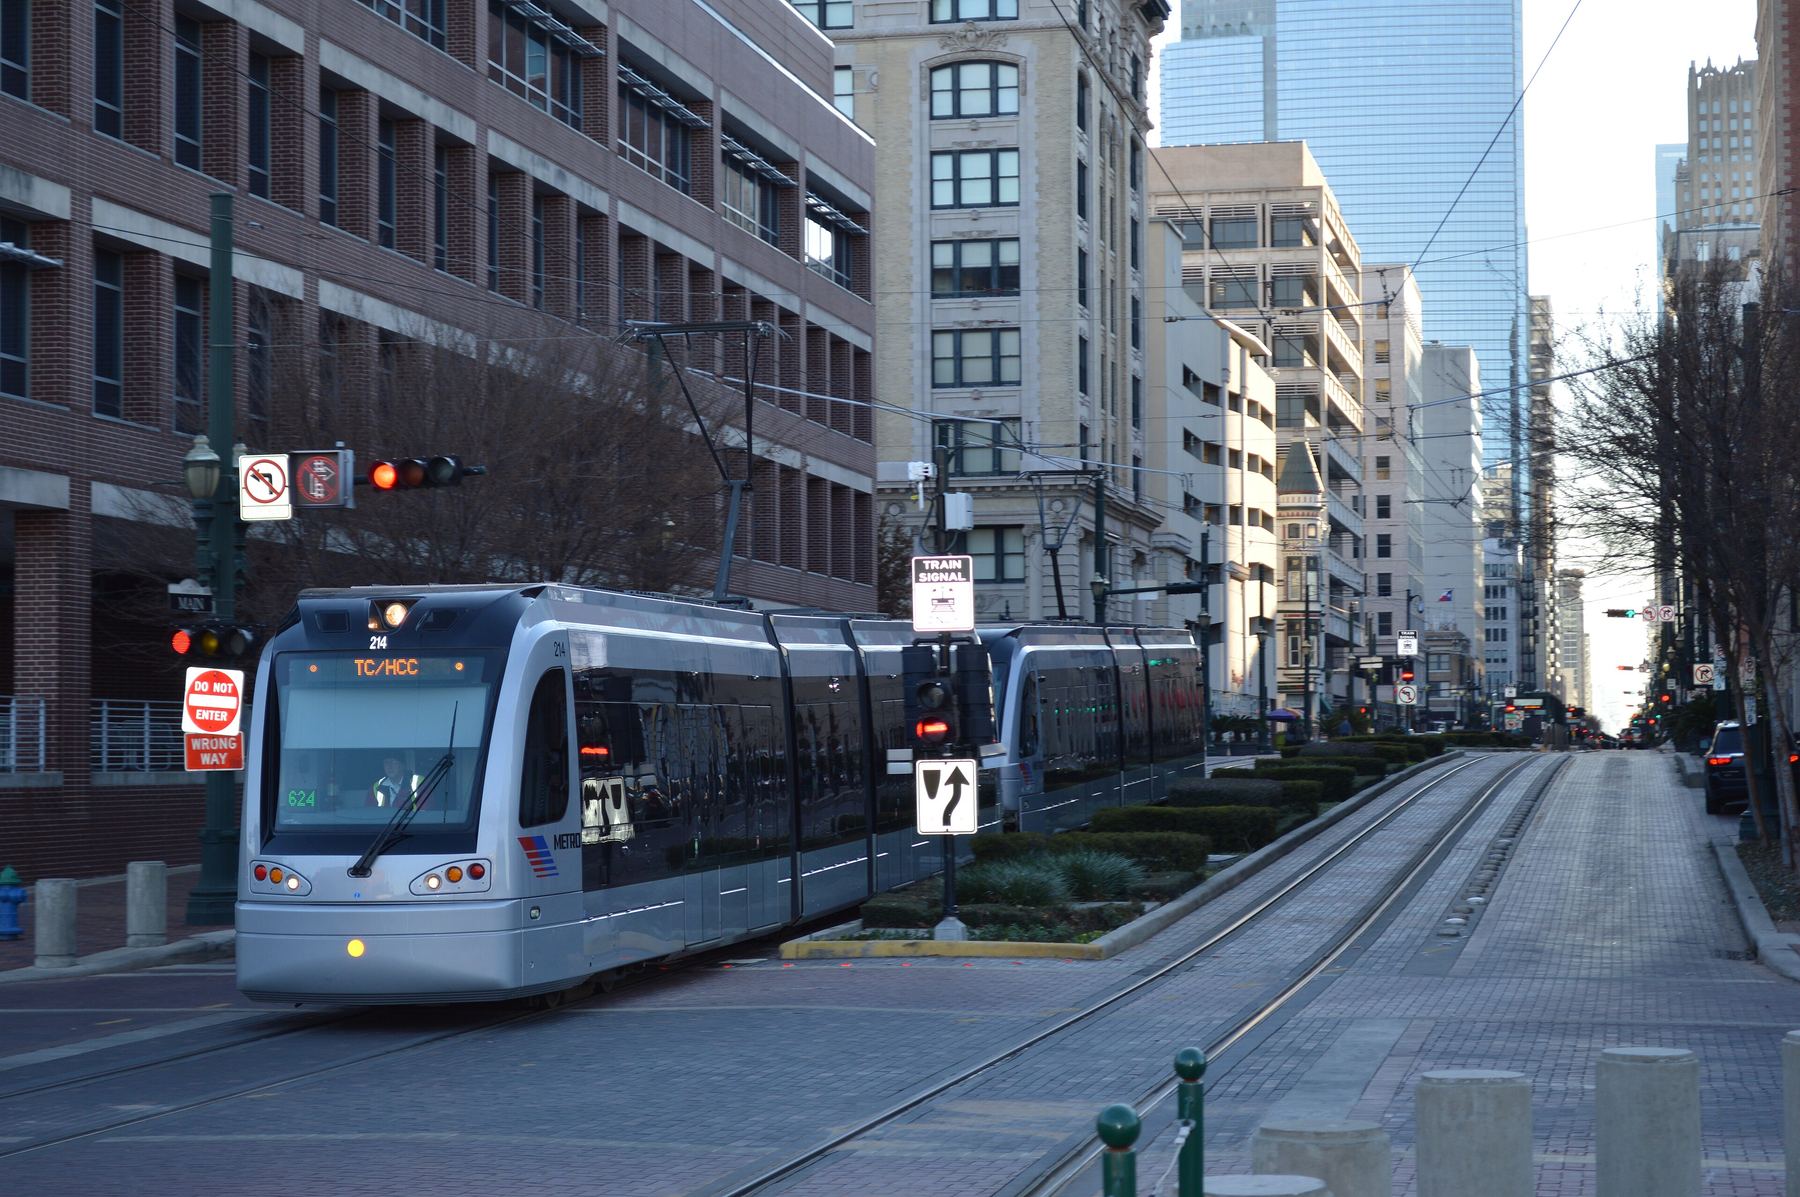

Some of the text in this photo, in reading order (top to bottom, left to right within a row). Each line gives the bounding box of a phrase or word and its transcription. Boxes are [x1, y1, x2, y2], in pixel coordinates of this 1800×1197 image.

[922, 559, 962, 570] TRAIN
[918, 572, 967, 582] SIGNAL
[369, 636, 387, 650] 214
[553, 641, 566, 657] 214
[354, 658, 419, 676] TC/HCC
[194, 681, 234, 693] DO NOT
[195, 709, 228, 721] ENTER
[191, 737, 237, 751] WRONG
[200, 752, 228, 765] WAY
[288, 790, 315, 807] 624
[553, 833, 581, 850] METRO
